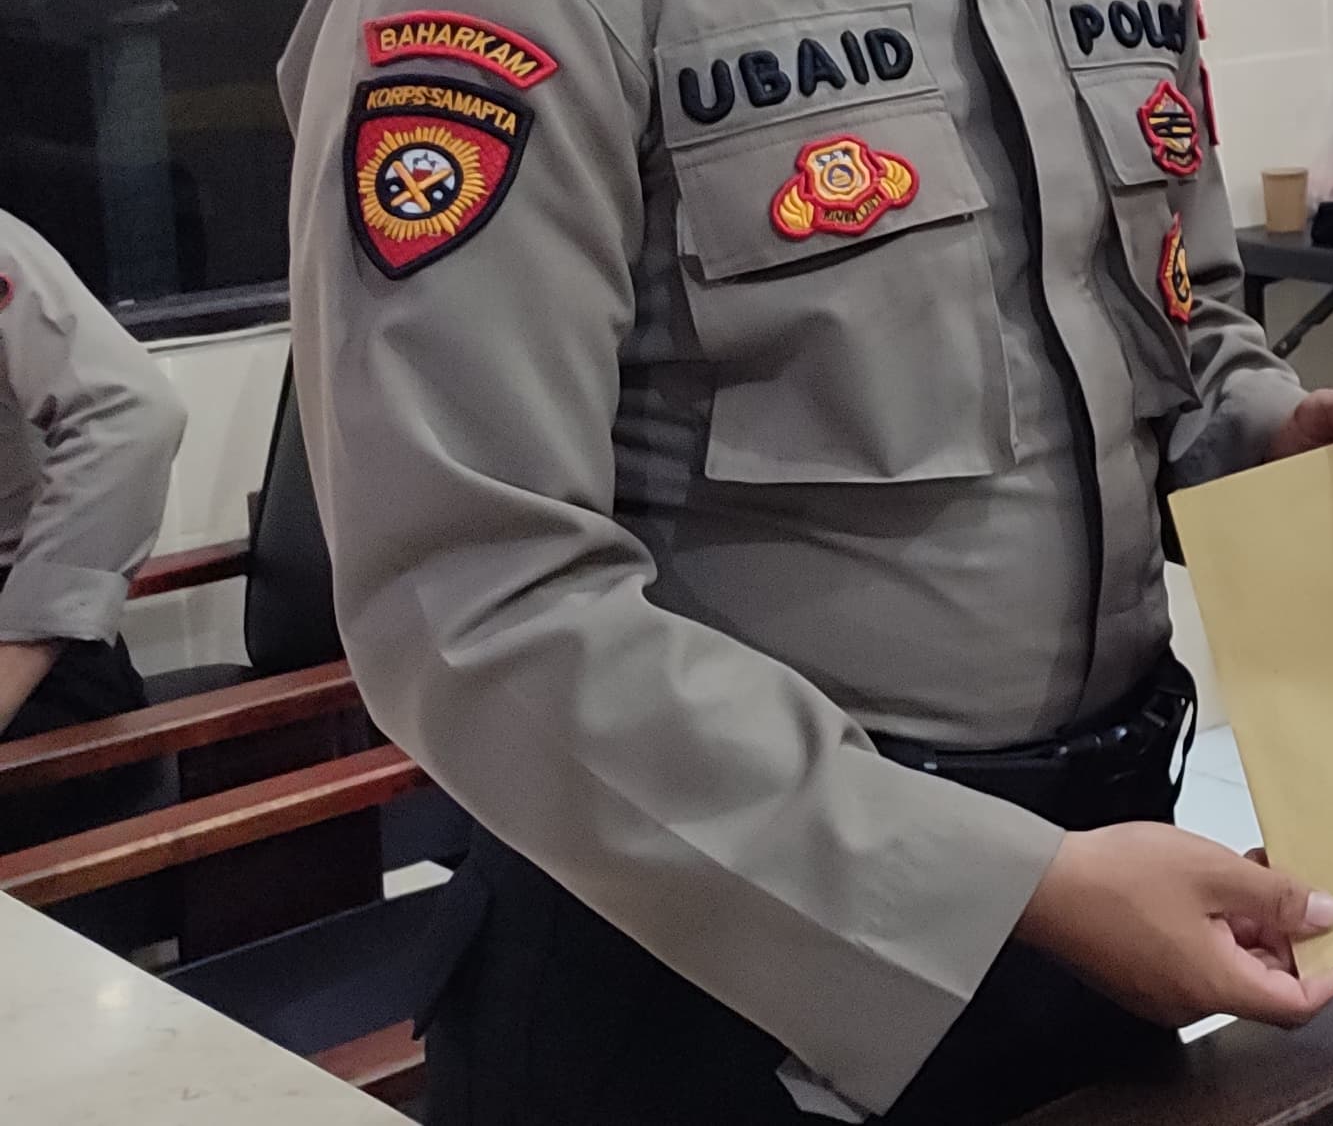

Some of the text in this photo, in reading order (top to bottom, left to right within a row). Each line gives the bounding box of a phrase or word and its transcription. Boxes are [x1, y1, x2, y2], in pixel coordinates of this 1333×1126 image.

[379, 22, 538, 78] BAHARKAM
[678, 26, 914, 124] UBAID
[366, 85, 517, 137] KORPS SAMAPTA
